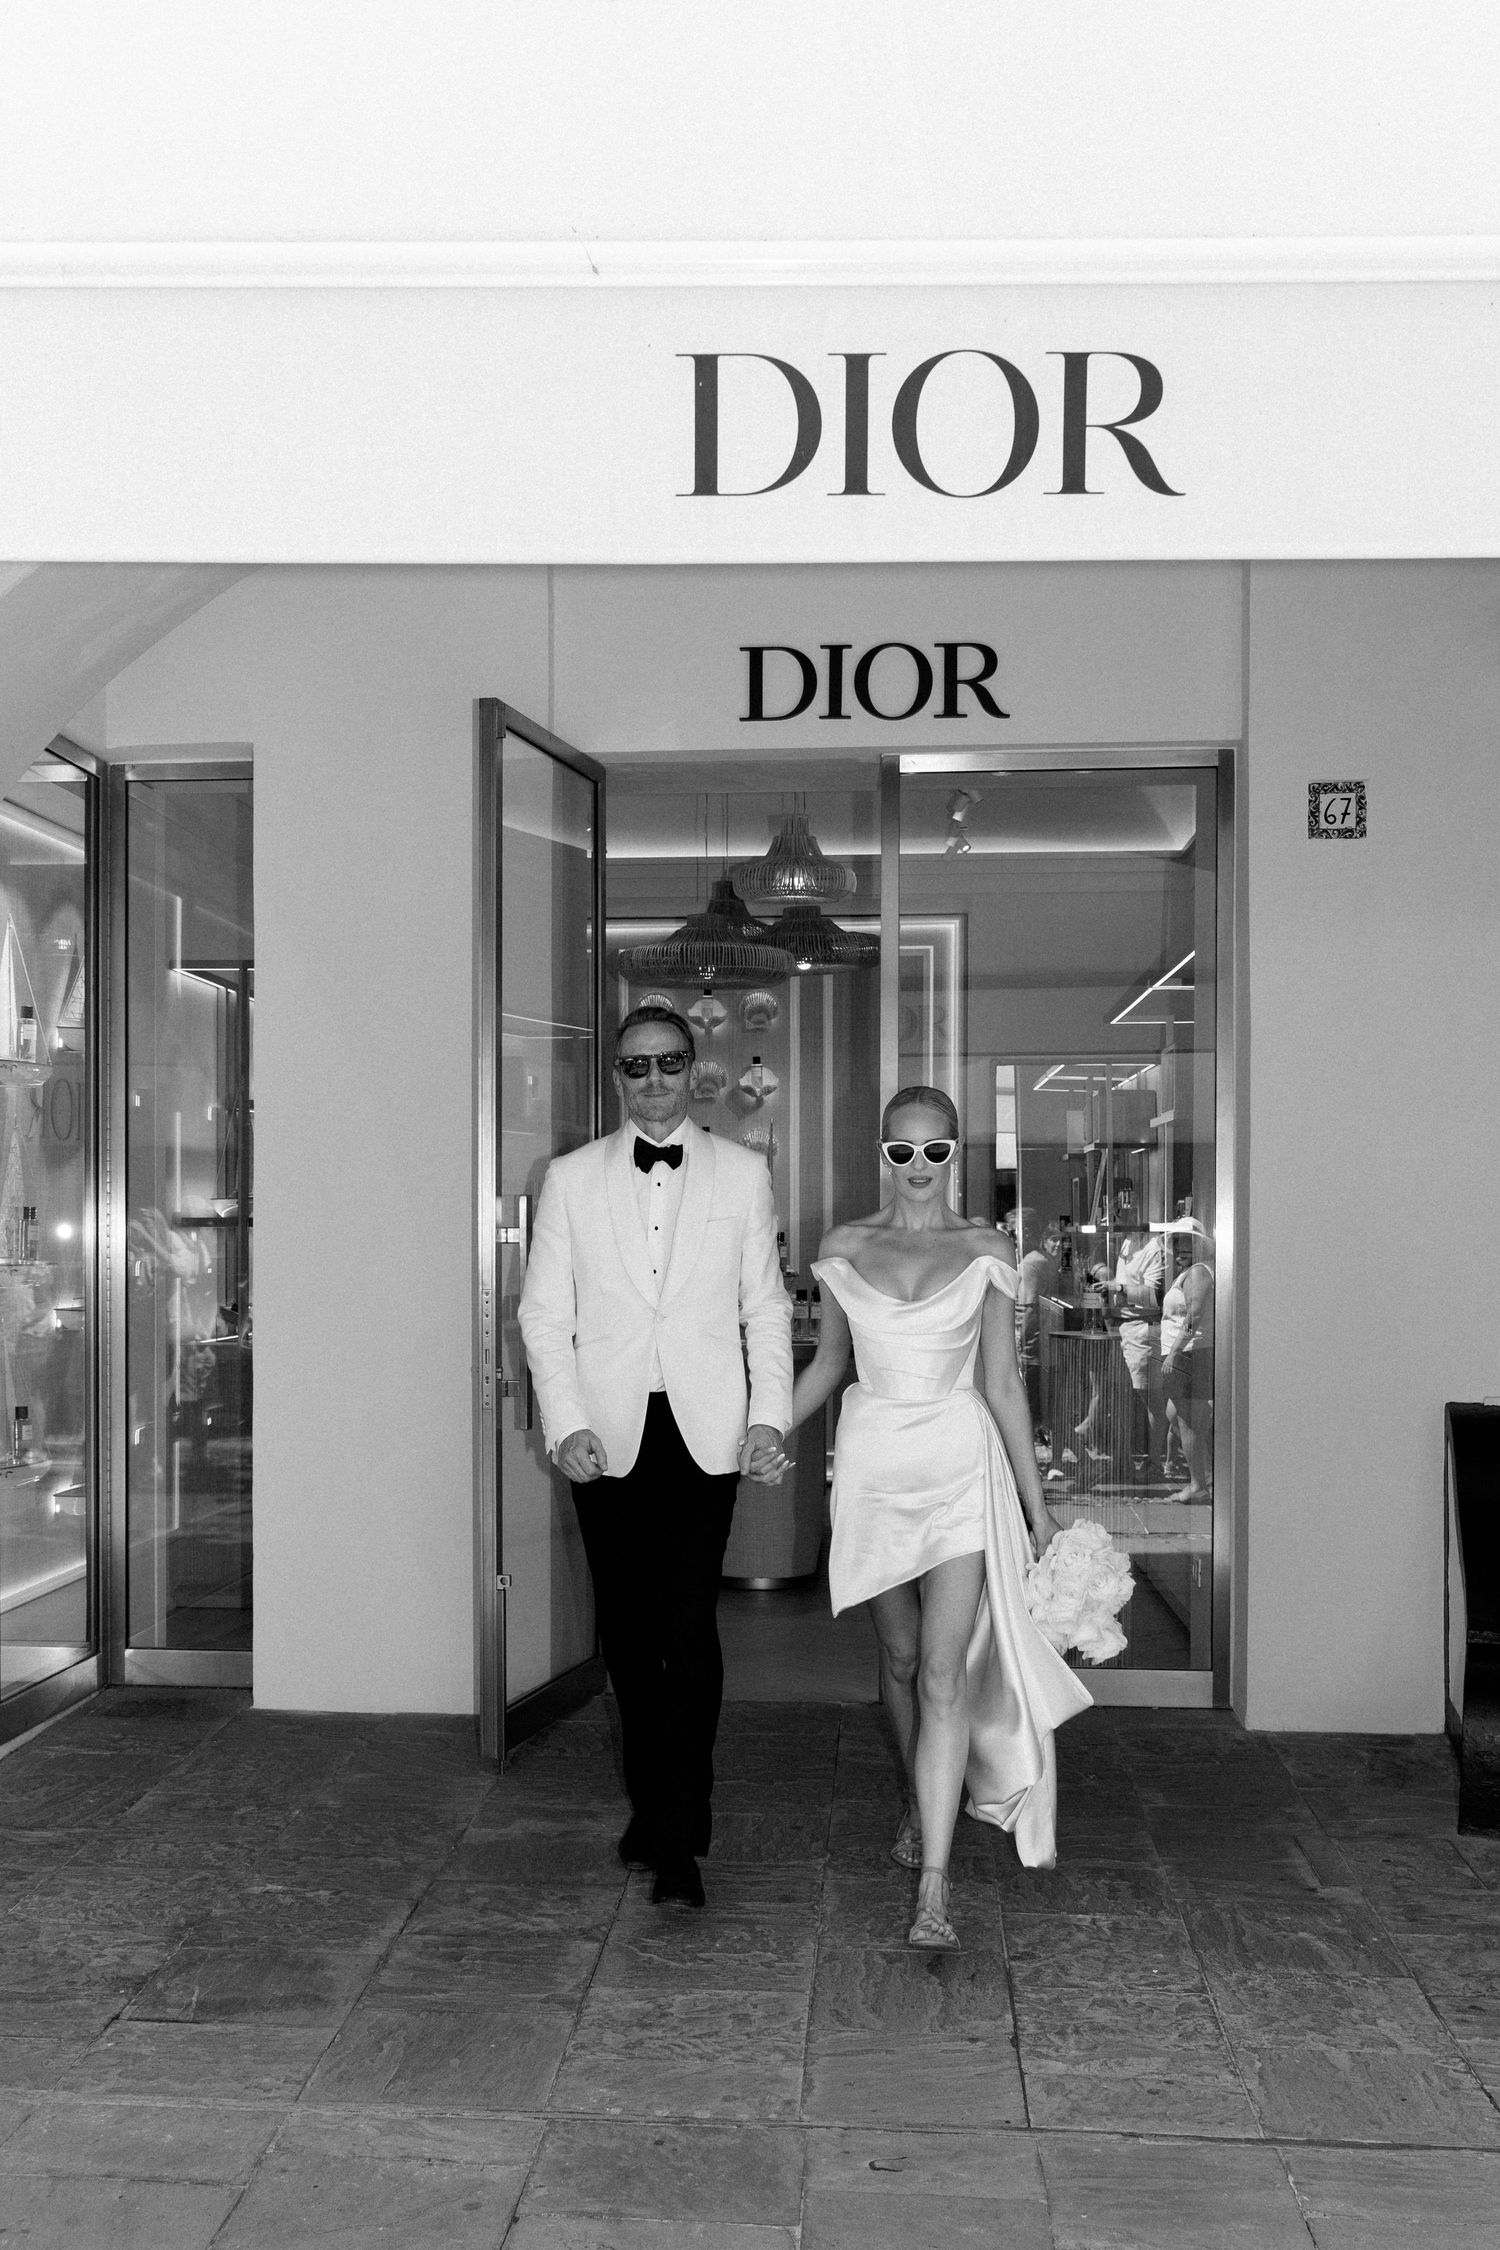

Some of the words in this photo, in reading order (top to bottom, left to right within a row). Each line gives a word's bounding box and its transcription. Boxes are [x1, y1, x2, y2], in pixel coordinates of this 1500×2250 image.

[676, 350, 1185, 499] DIOR
[739, 642, 1011, 722] DIOR
[1323, 797, 1352, 825] 67
